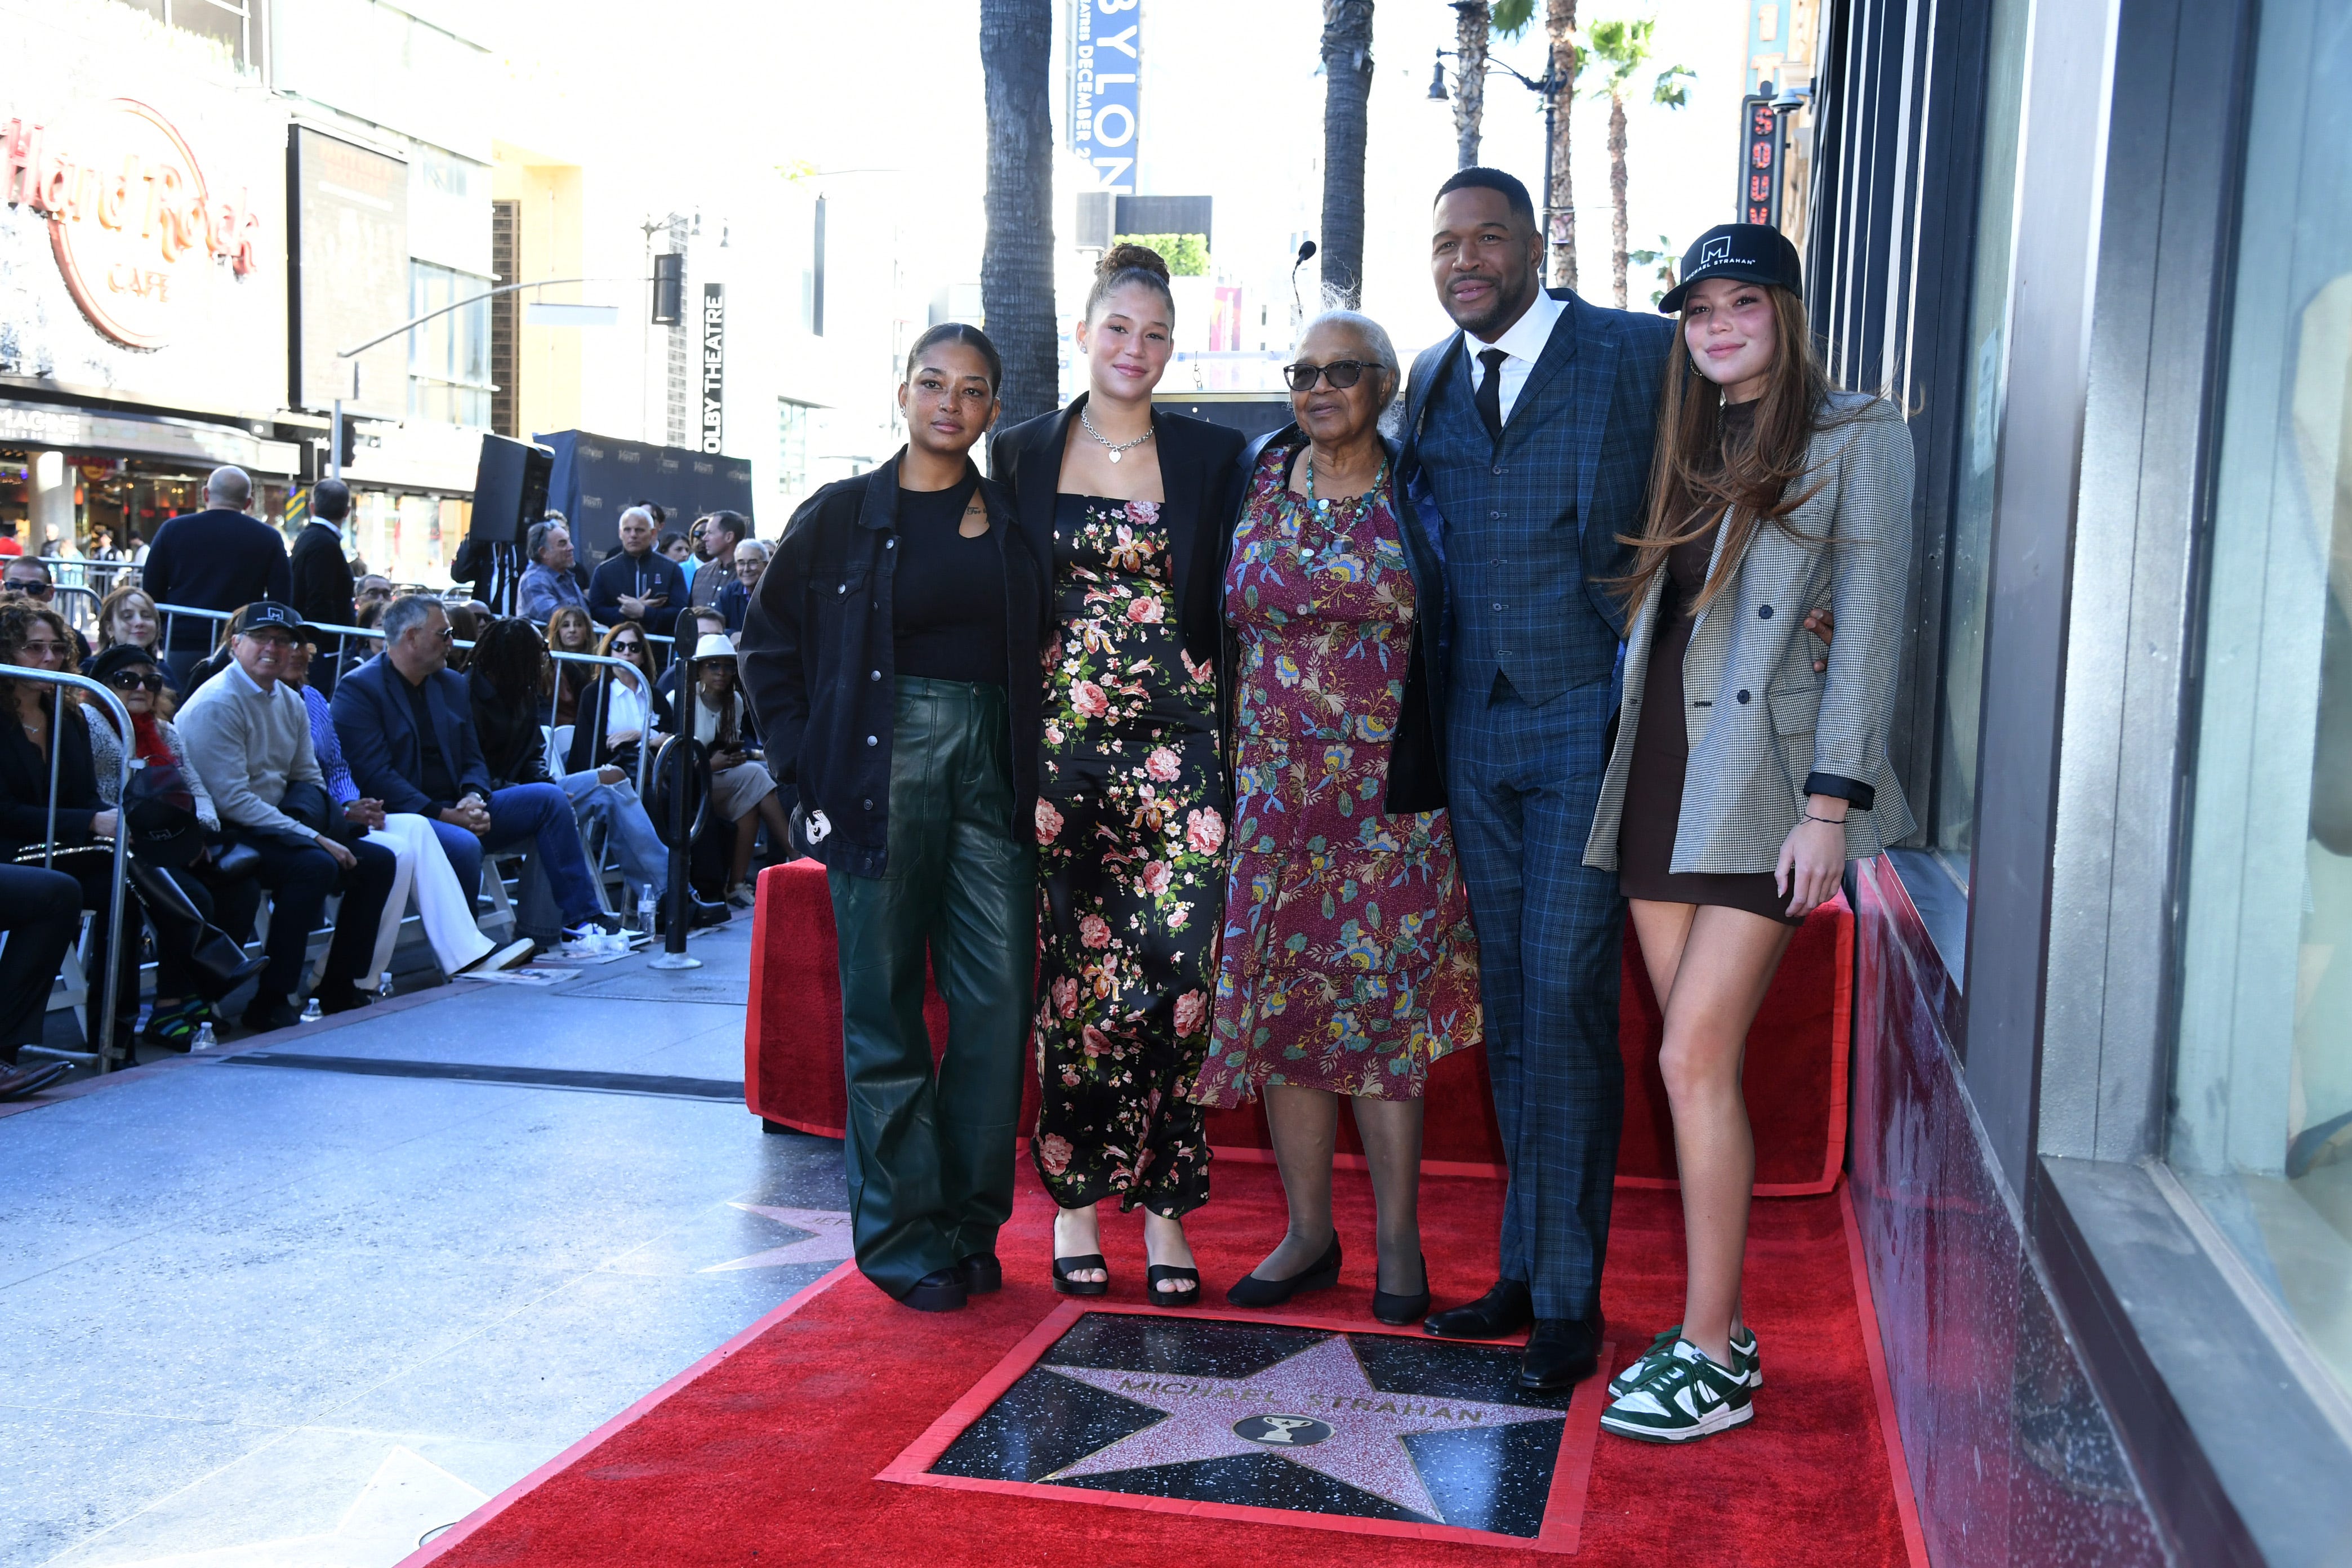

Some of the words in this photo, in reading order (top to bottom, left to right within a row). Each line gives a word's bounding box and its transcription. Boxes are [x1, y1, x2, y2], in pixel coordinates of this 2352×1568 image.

[1076, 46, 1094, 141] DECEMBER
[0, 117, 140, 233] Hard
[142, 163, 259, 276] Rock
[108, 264, 171, 302] CAFE
[1686, 262, 1711, 282] MICHAEL
[704, 295, 723, 394] THEATRE
[802, 1218, 853, 1226] JEF
[1119, 1380, 1281, 1404] MICHAEL
[1307, 1394, 1482, 1422] STRAHAN
